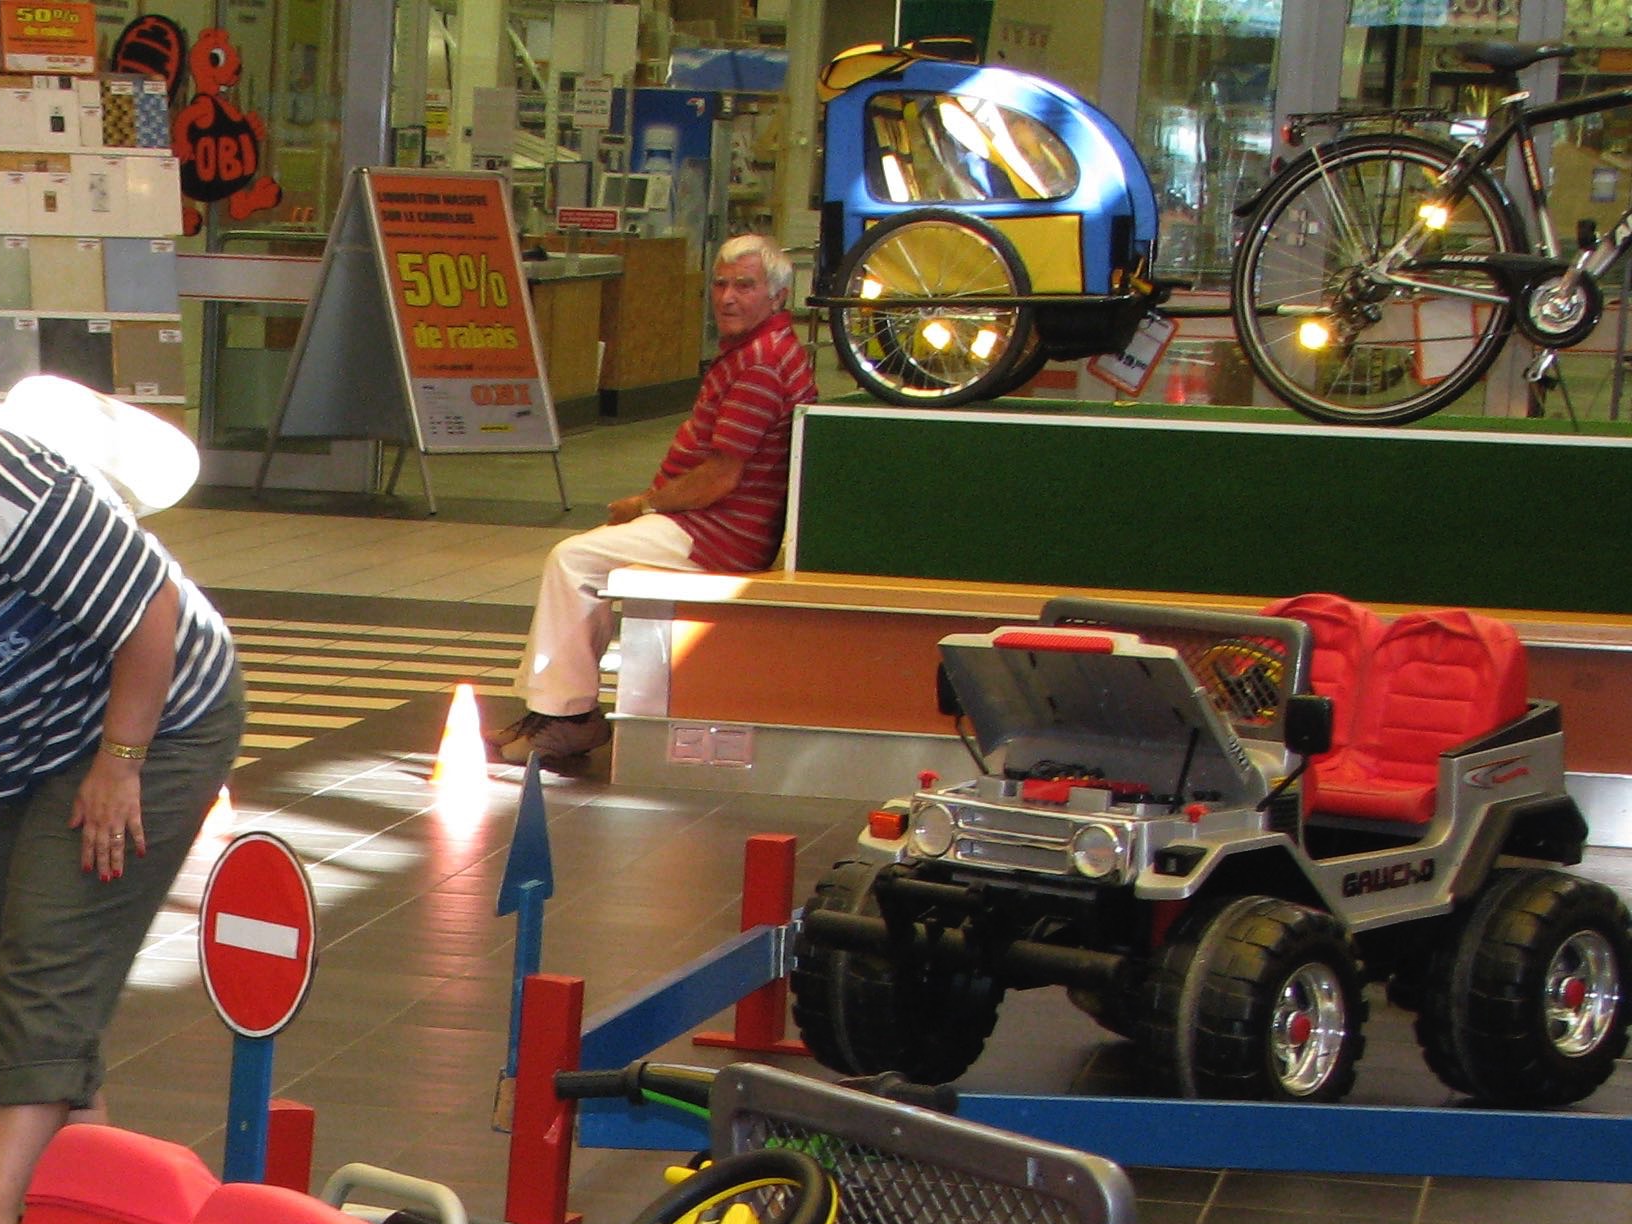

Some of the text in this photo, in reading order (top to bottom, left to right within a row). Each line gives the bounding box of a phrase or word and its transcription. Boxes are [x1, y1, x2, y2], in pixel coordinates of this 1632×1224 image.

[16, 8, 80, 23] 50%
[196, 133, 257, 182] OBI
[378, 191, 440, 204] LIQUIDATION
[382, 210, 401, 221] SUR
[403, 211, 416, 222] LE
[396, 252, 509, 308] 50%
[413, 321, 518, 349] de rabais
[471, 384, 533, 406] OBI
